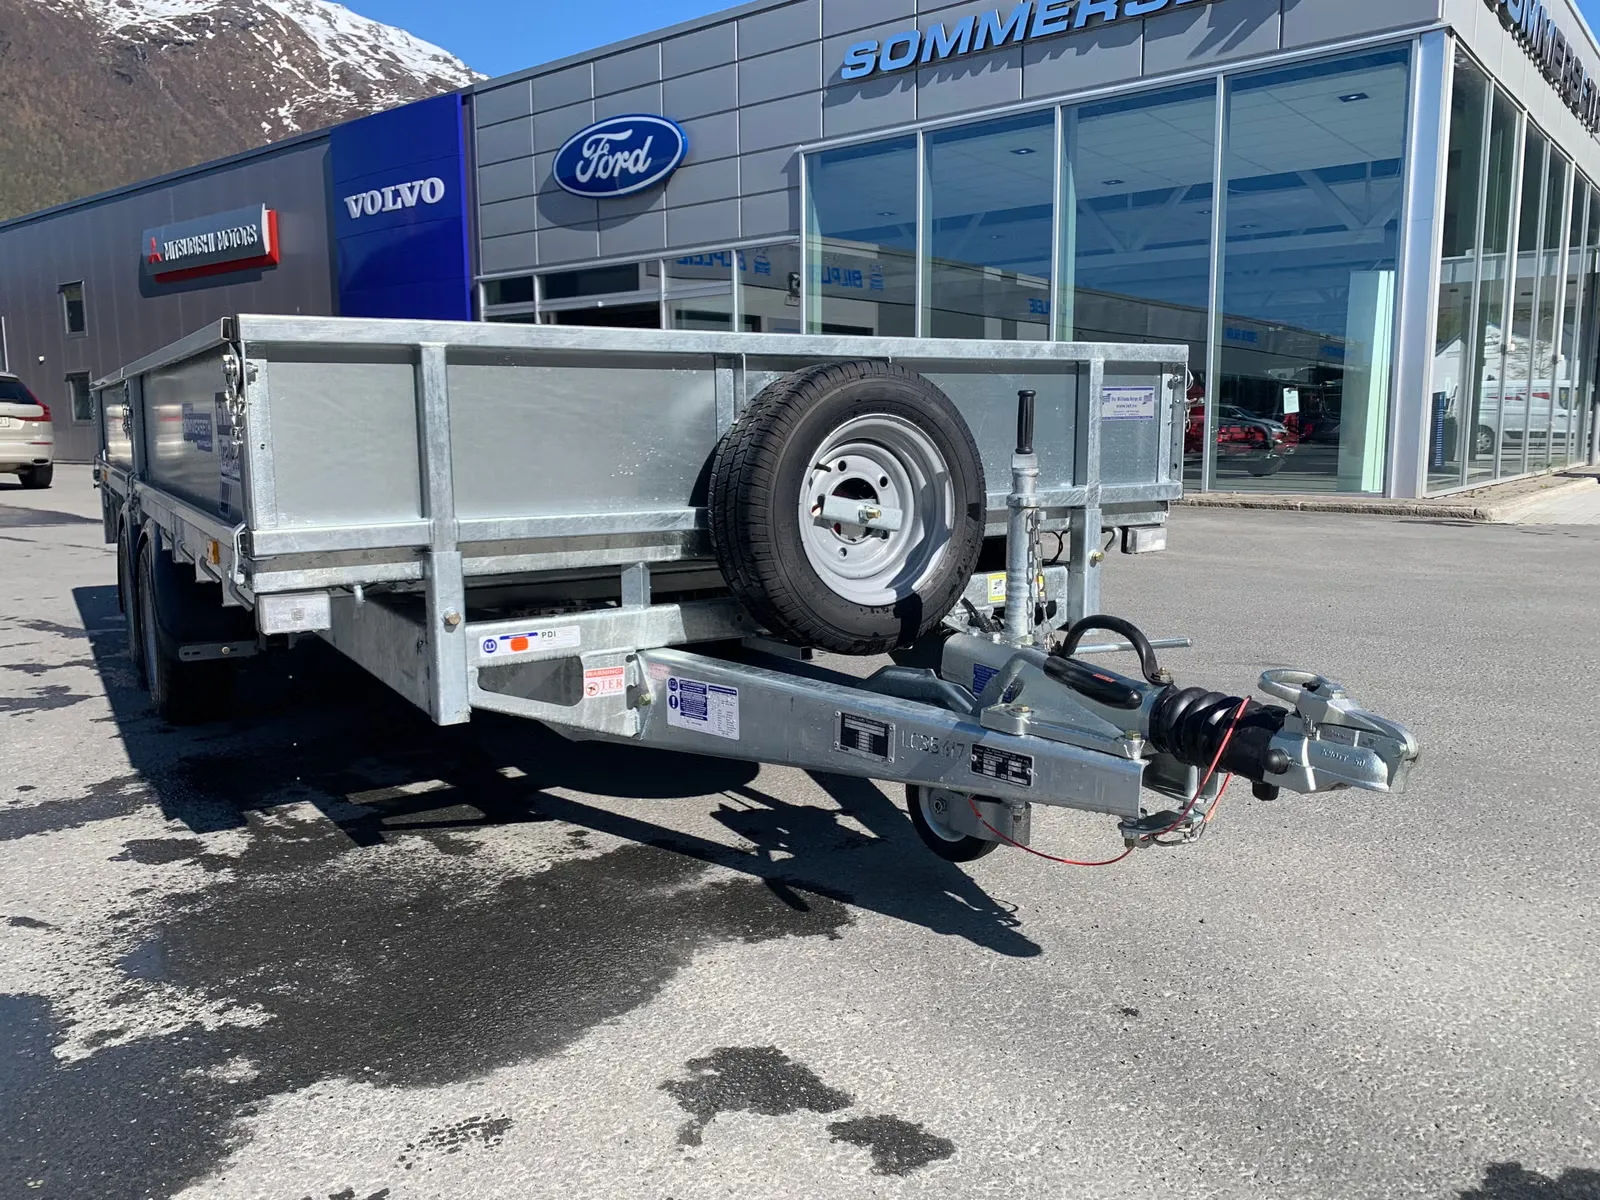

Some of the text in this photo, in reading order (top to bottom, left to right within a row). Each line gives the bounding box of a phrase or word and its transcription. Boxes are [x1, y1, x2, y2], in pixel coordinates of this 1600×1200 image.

[574, 128, 653, 183] Ford
[344, 176, 445, 219] VOLVO
[163, 224, 258, 261] MITSUBISHI MOTORS
[541, 630, 557, 639] PDI
[586, 668, 623, 677] WARNING!
